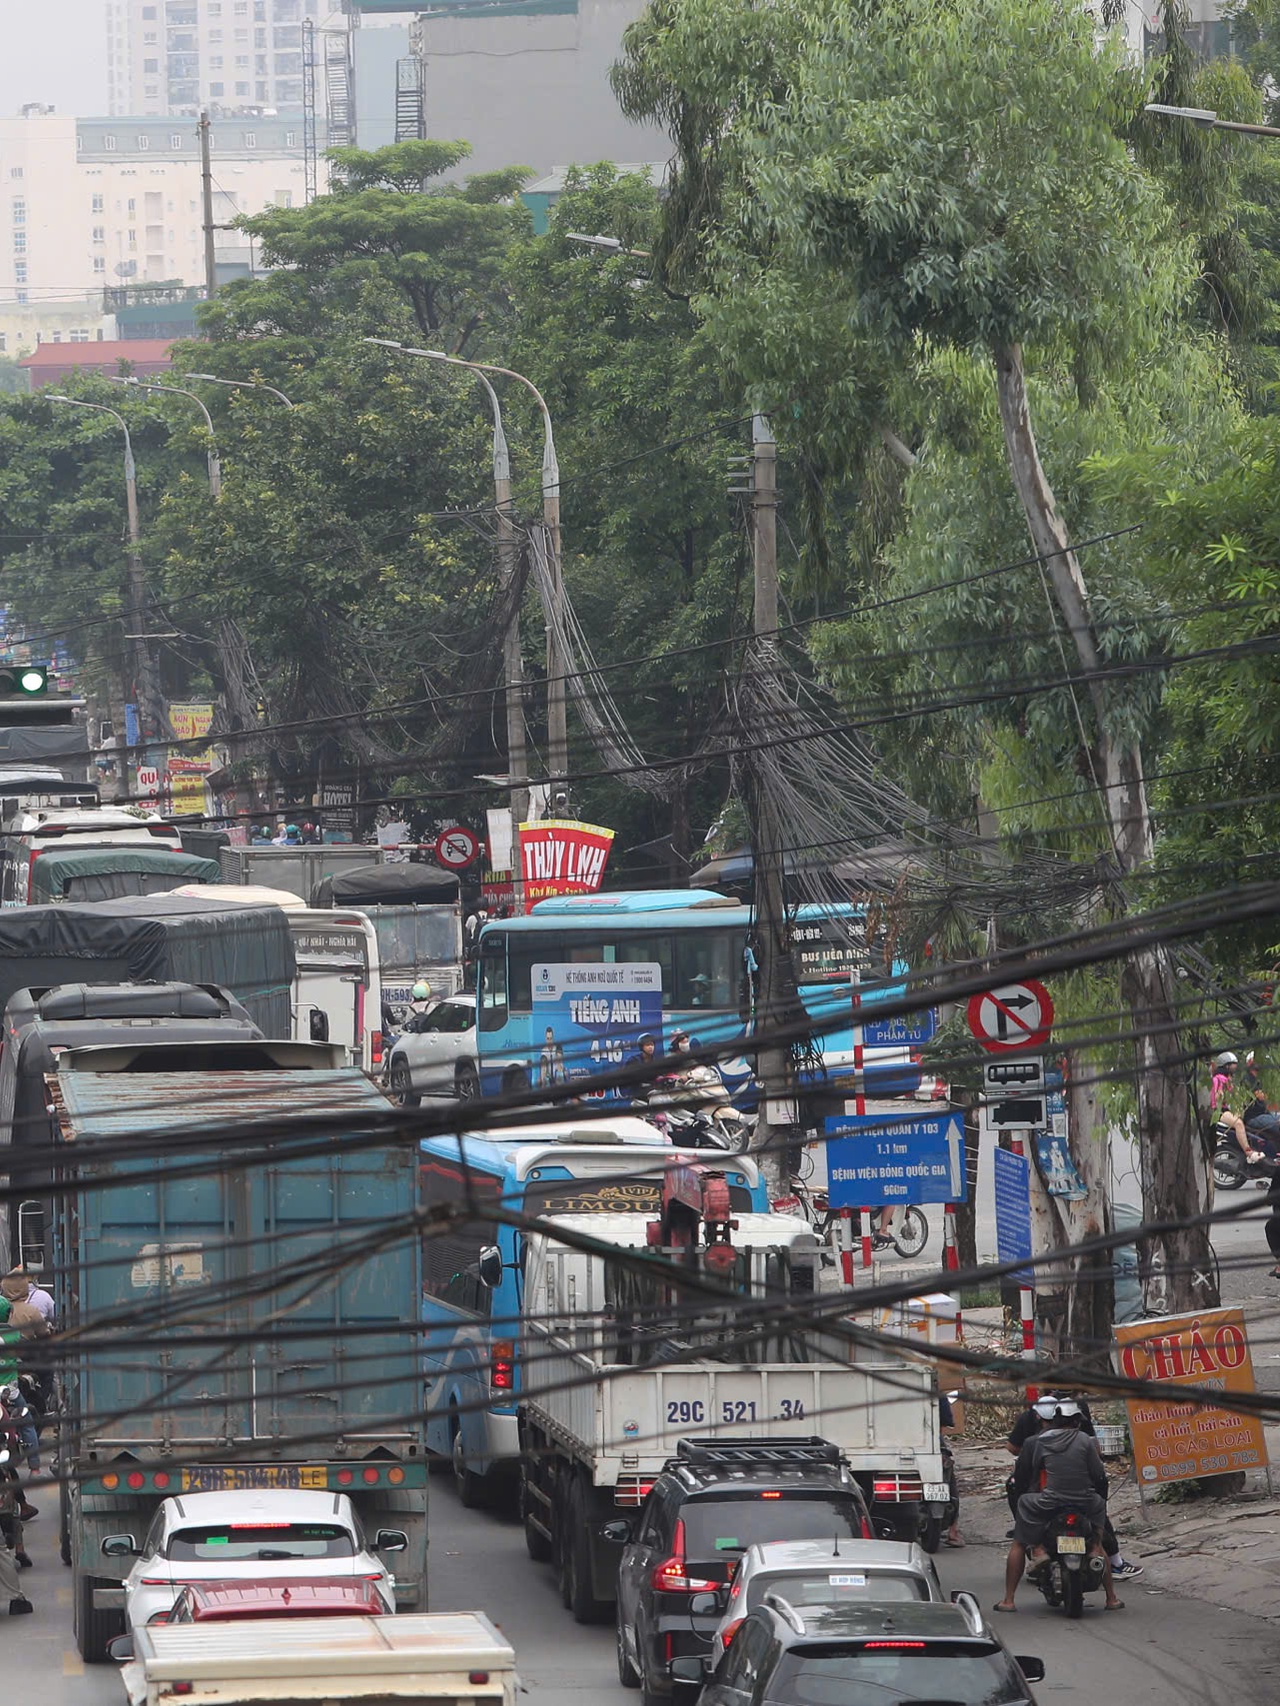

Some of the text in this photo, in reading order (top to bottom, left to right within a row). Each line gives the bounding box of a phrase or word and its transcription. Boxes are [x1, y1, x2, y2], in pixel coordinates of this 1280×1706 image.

[801, 951, 820, 963] BUS
[570, 994, 640, 1023] TIẾNG ANH
[590, 1040, 623, 1062] 4-16
[913, 1124, 920, 1134] Y
[922, 1123, 939, 1134] 103
[877, 1144, 908, 1154] 1.1 km
[832, 1167, 856, 1181] BỆNH
[858, 1166, 878, 1180] VIỆN
[906, 1161, 929, 1177] QUỐC
[932, 1165, 946, 1175] GIA
[544, 1200, 655, 1212] LIMOU
[1122, 1320, 1246, 1381] CHÁO
[667, 1401, 704, 1423] 29C
[723, 1402, 756, 1422] 521
[1134, 1408, 1163, 1423] cháo
[1175, 1435, 1209, 1455] CÁC
[1200, 1454, 1228, 1471] 530
[1232, 1450, 1259, 1465] 782
